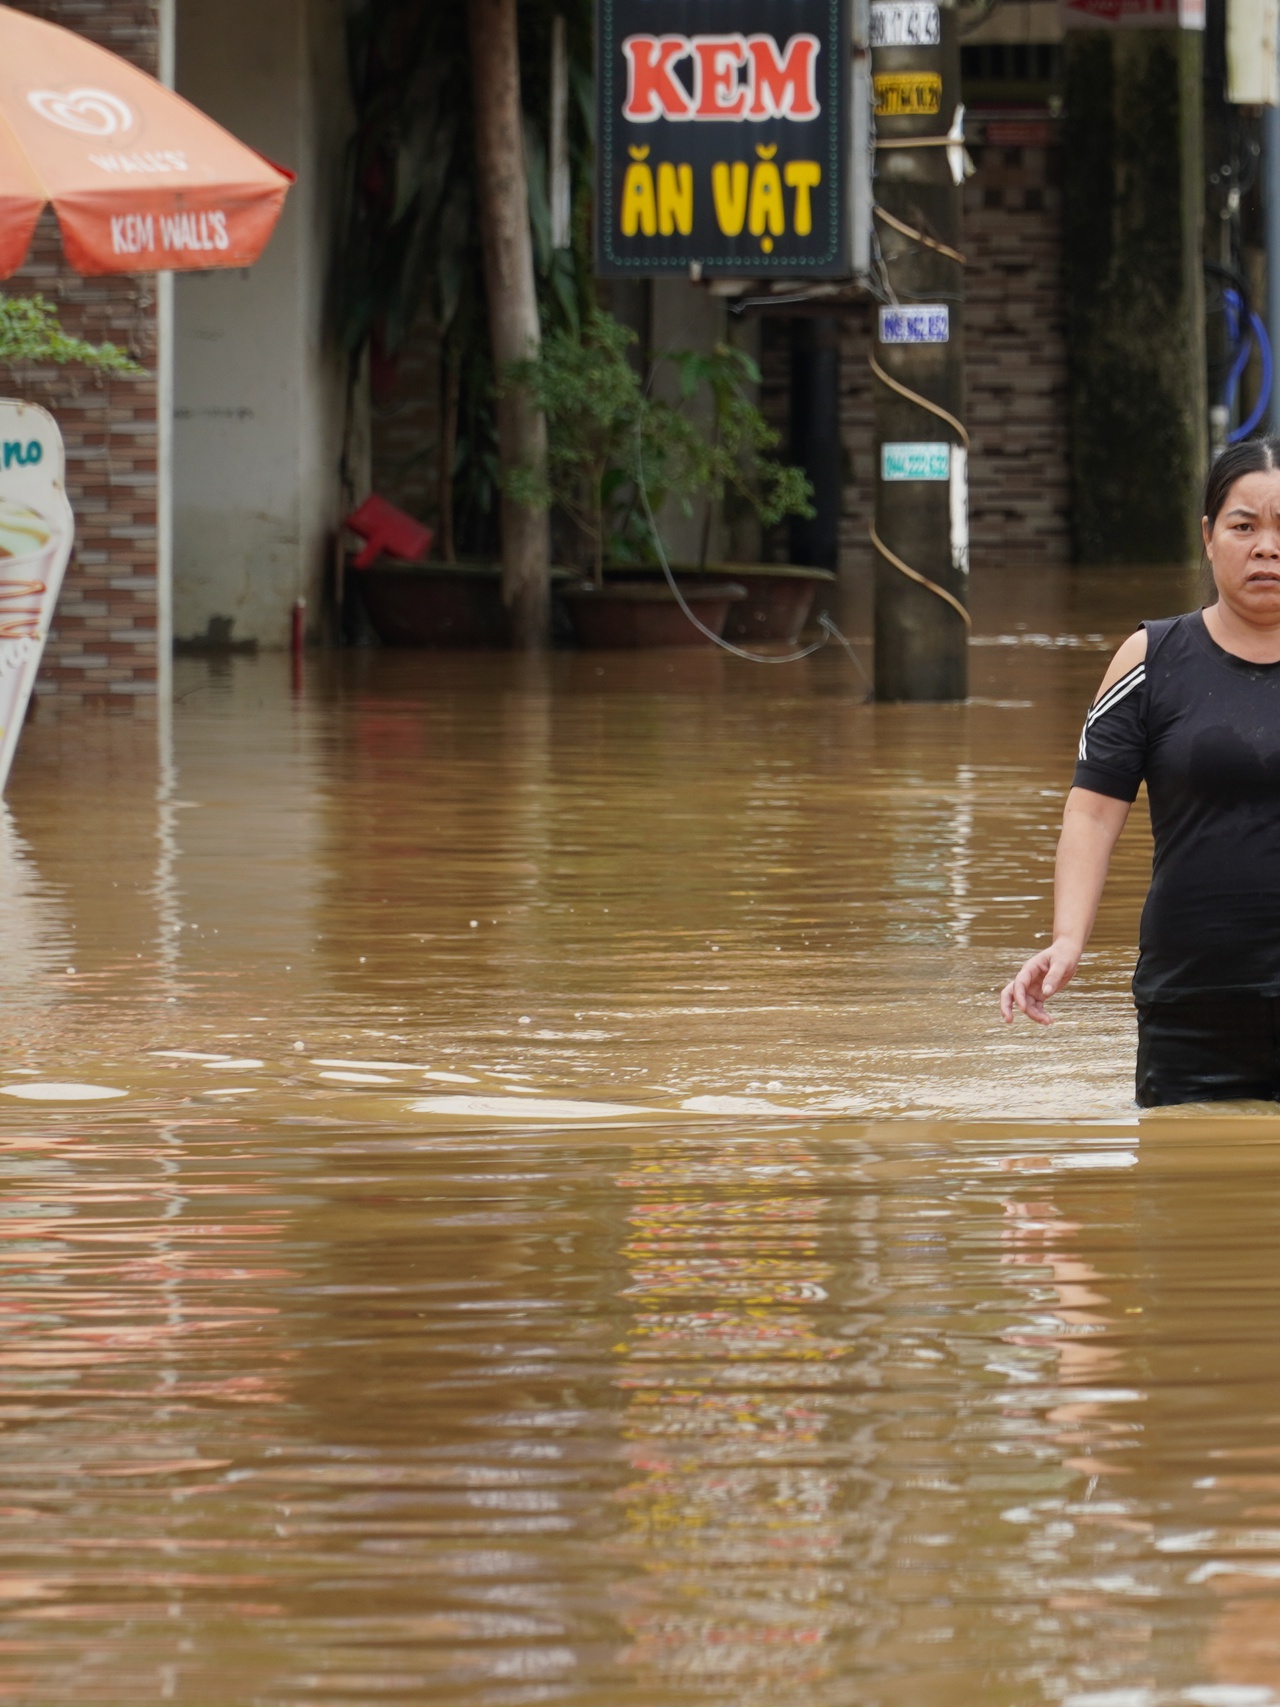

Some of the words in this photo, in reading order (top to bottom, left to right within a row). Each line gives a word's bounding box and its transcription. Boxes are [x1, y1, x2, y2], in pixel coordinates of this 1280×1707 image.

[622, 33, 821, 123] KEM
[88, 150, 188, 172] WALL'S
[620, 143, 694, 237] ĂN
[711, 142, 821, 254] VẶT
[110, 213, 155, 254] KEM
[159, 209, 229, 251] WALL'S
[0, 440, 43, 470] no
